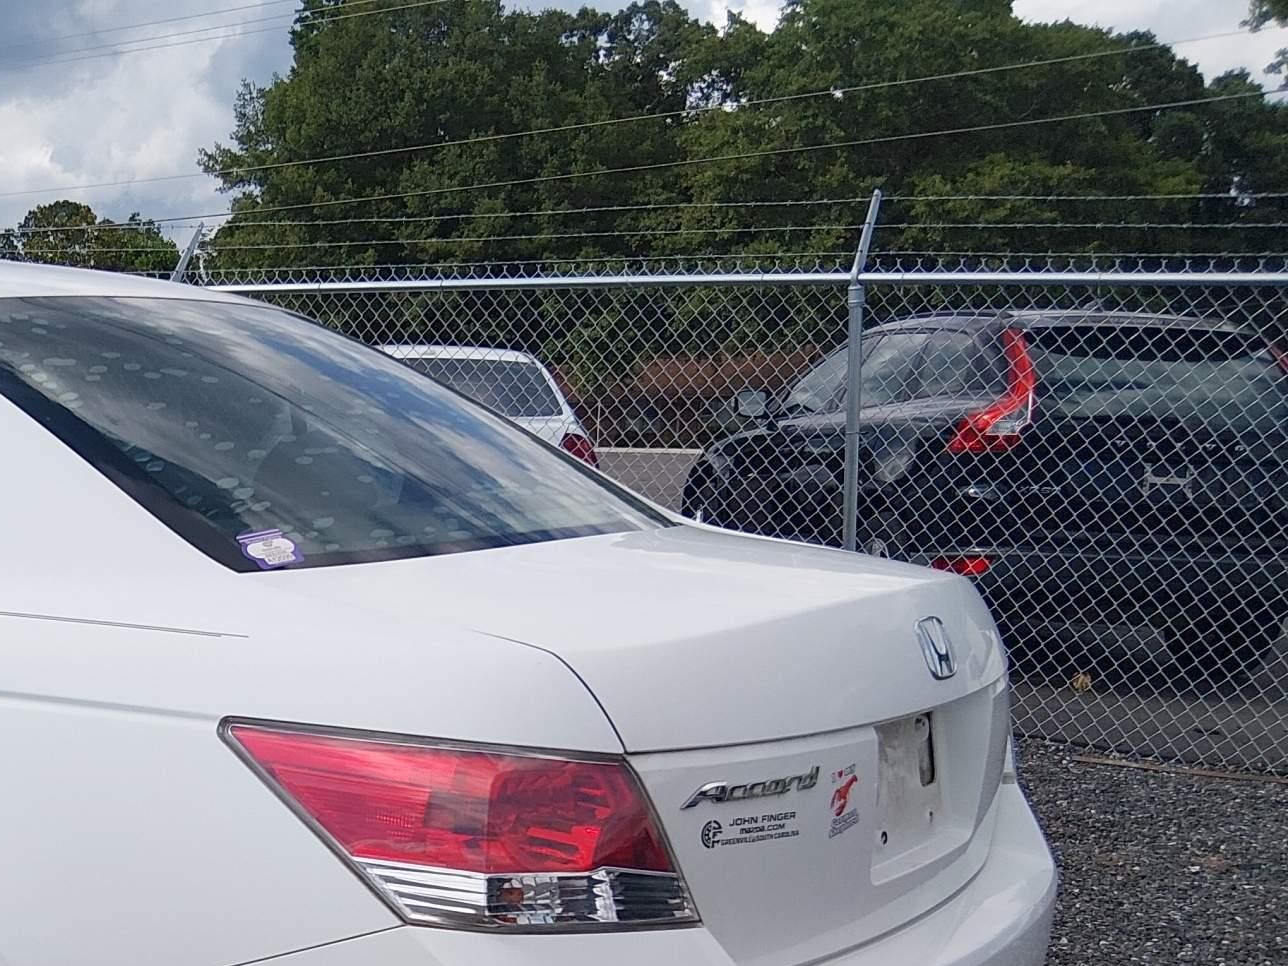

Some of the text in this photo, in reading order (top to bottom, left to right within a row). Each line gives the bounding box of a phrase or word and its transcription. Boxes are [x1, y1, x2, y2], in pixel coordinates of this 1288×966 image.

[679, 765, 820, 810] Accord
[729, 811, 796, 827] JOHN FINGER
